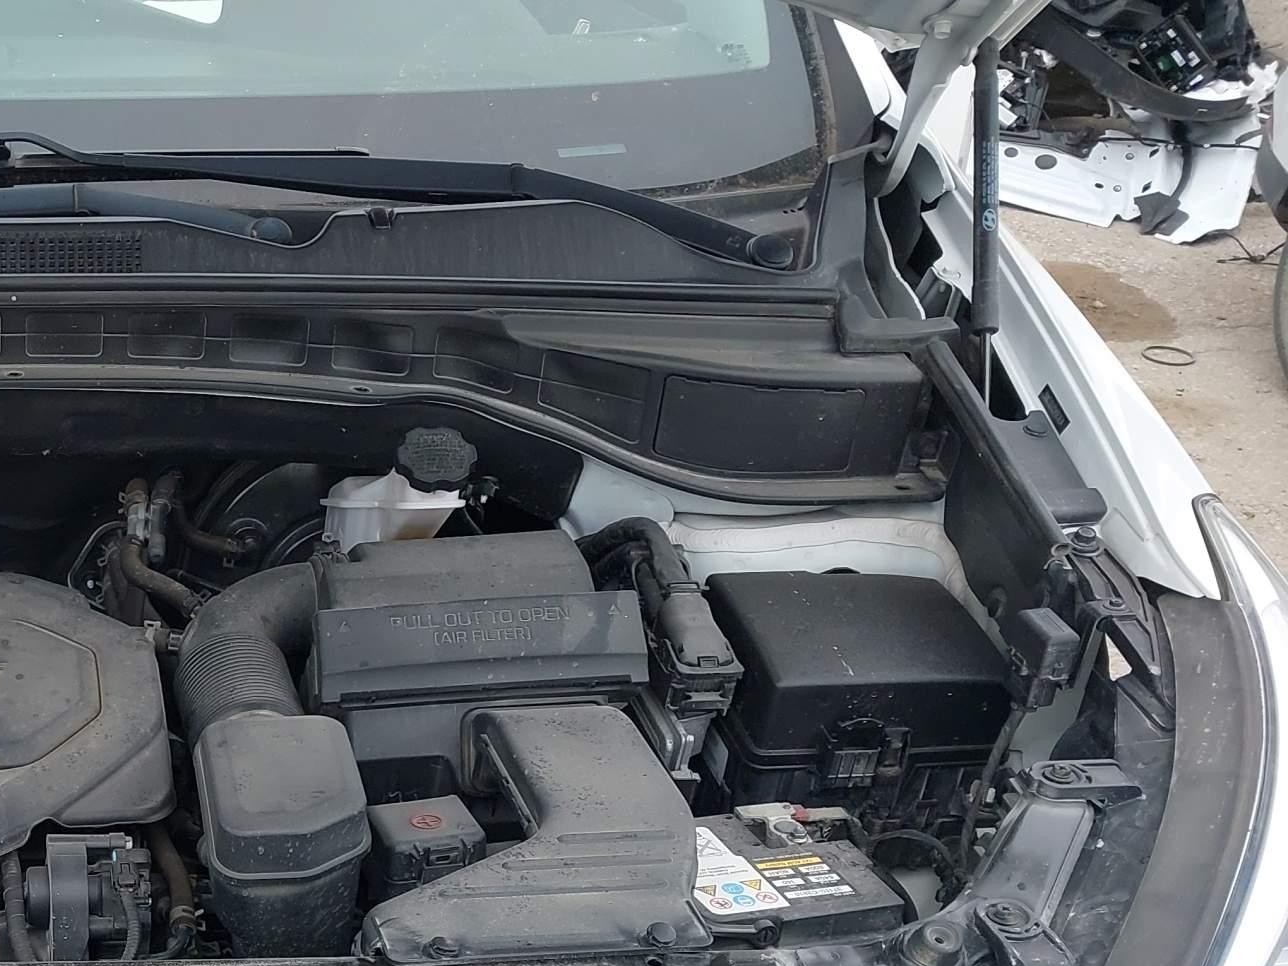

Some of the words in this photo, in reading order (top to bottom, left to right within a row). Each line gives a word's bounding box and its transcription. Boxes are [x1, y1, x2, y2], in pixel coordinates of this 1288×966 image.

[390, 614, 440, 630] PULL
[444, 610, 483, 627] OUT
[488, 609, 513, 625] TO
[518, 606, 570, 622] OPEN
